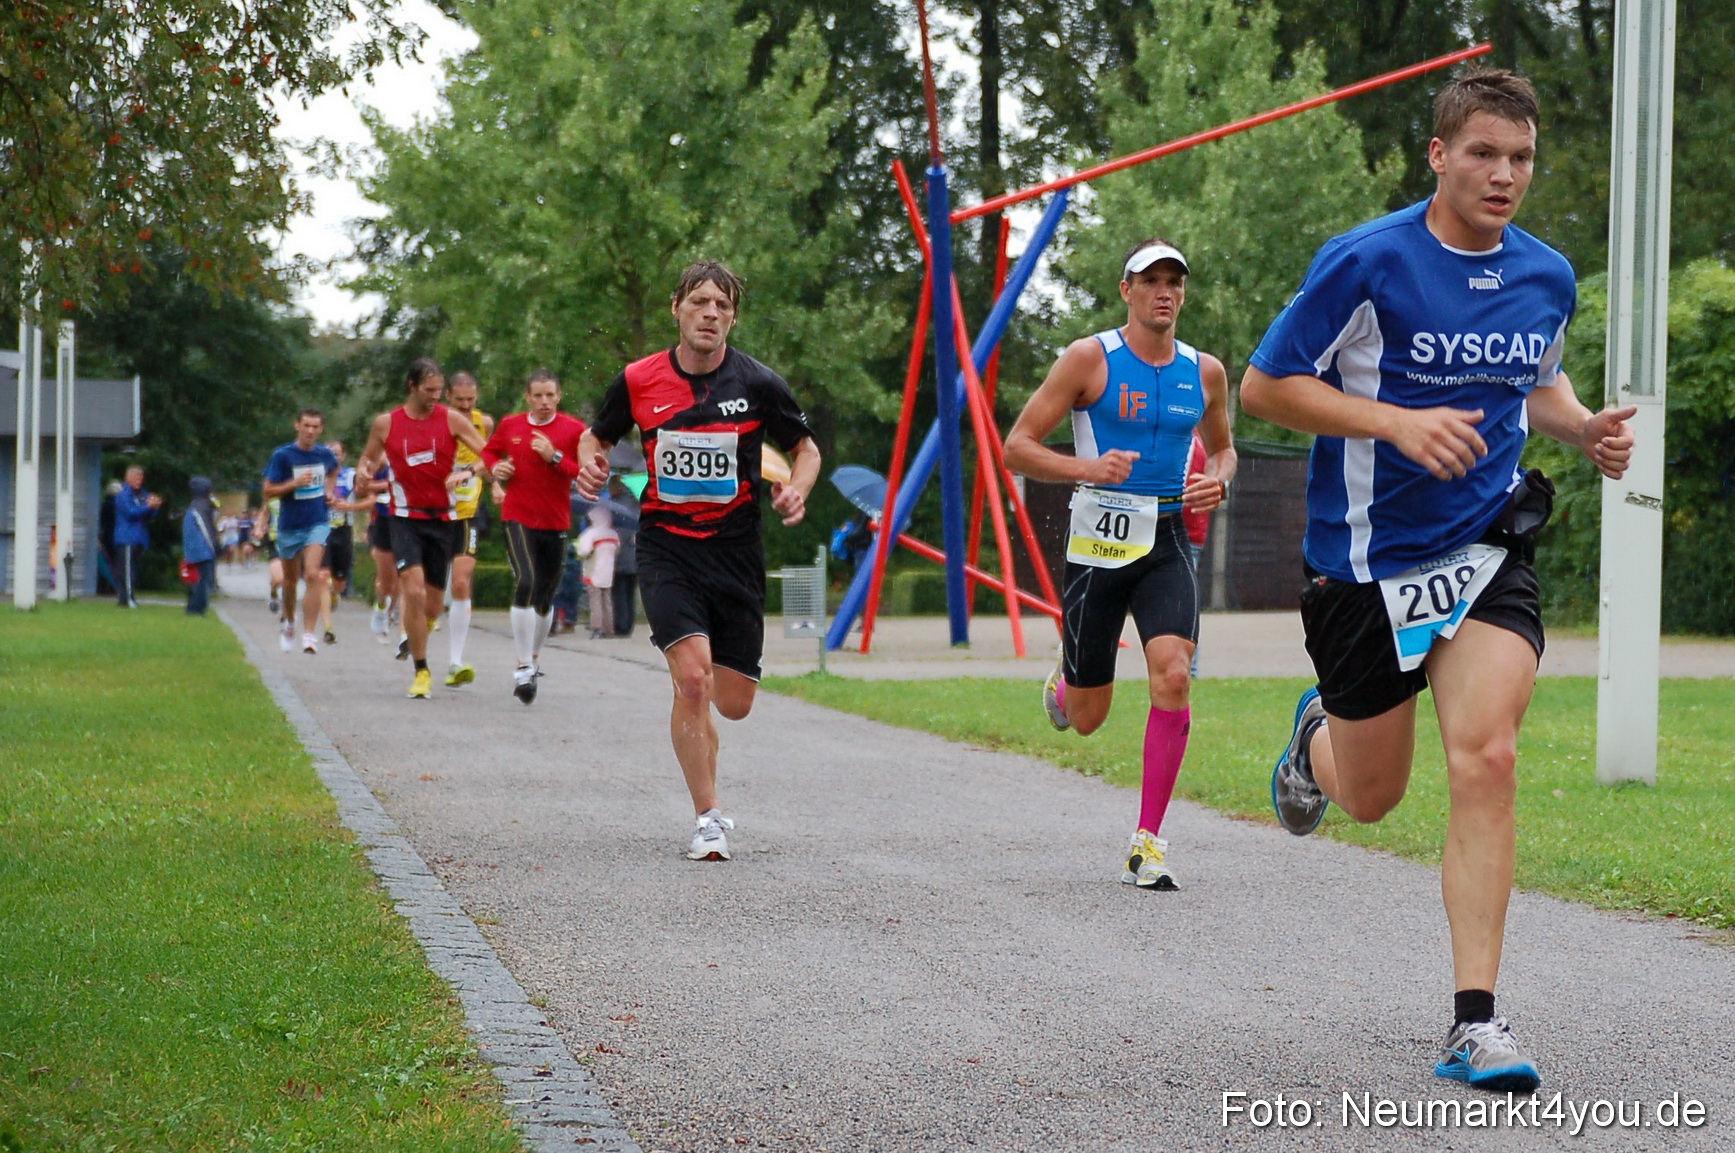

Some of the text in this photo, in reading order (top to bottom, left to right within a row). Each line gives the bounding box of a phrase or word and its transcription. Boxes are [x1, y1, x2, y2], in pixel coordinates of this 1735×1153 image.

[1468, 277, 1500, 290] PUMA
[1410, 331, 1546, 365] SYSCAD
[717, 397, 749, 417] T90
[661, 450, 730, 478] 3399
[1095, 511, 1131, 542] 40
[1091, 543, 1126, 558] Stefan
